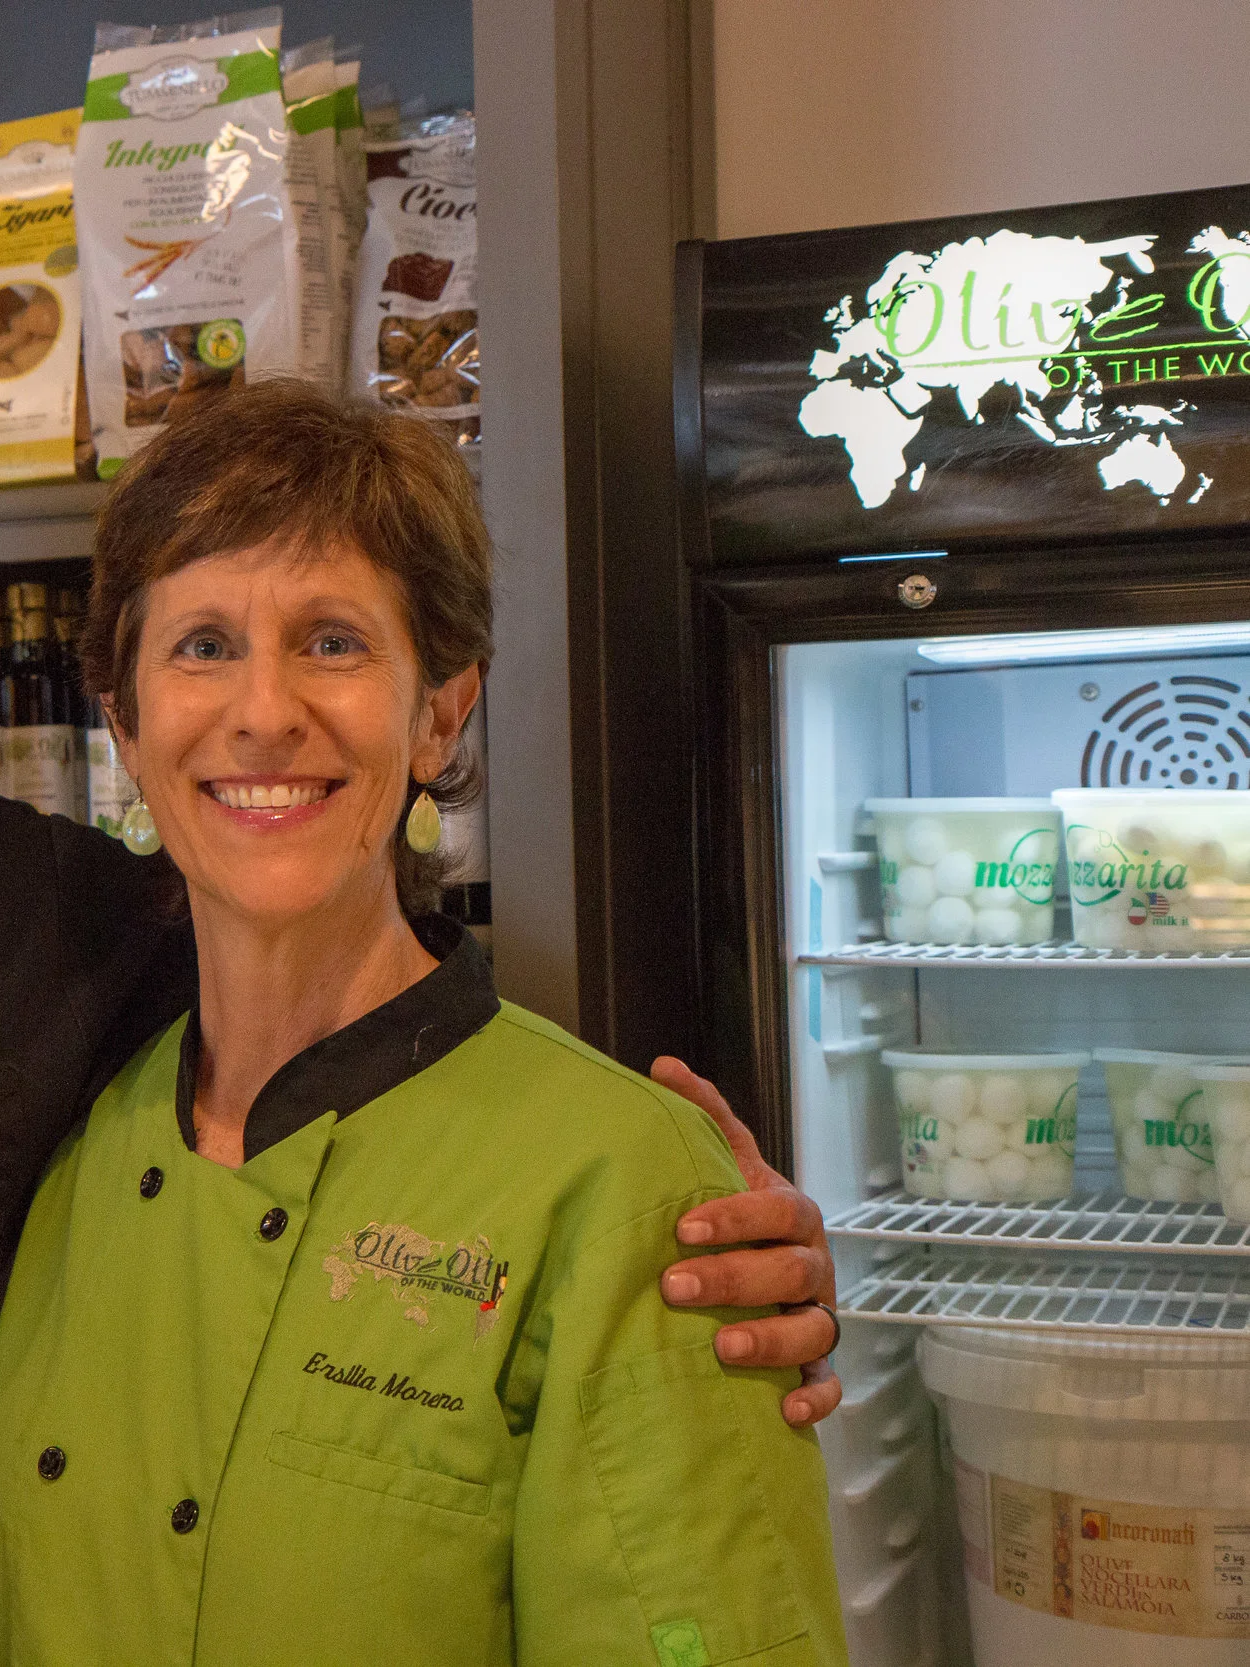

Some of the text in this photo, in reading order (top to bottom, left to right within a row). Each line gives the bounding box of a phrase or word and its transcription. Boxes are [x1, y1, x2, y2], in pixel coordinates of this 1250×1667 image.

[874, 269, 1165, 358] Olive
[1046, 360, 1092, 388] OF
[1108, 355, 1182, 384] THE
[400, 1277, 488, 1302] OF THE WORLD
[379, 1372, 465, 1411] Moreno
[1081, 1552, 1134, 1572] OLIVE
[1081, 1563, 1192, 1592] NOCELLARA
[1081, 1592, 1177, 1616] SALAMOIA
